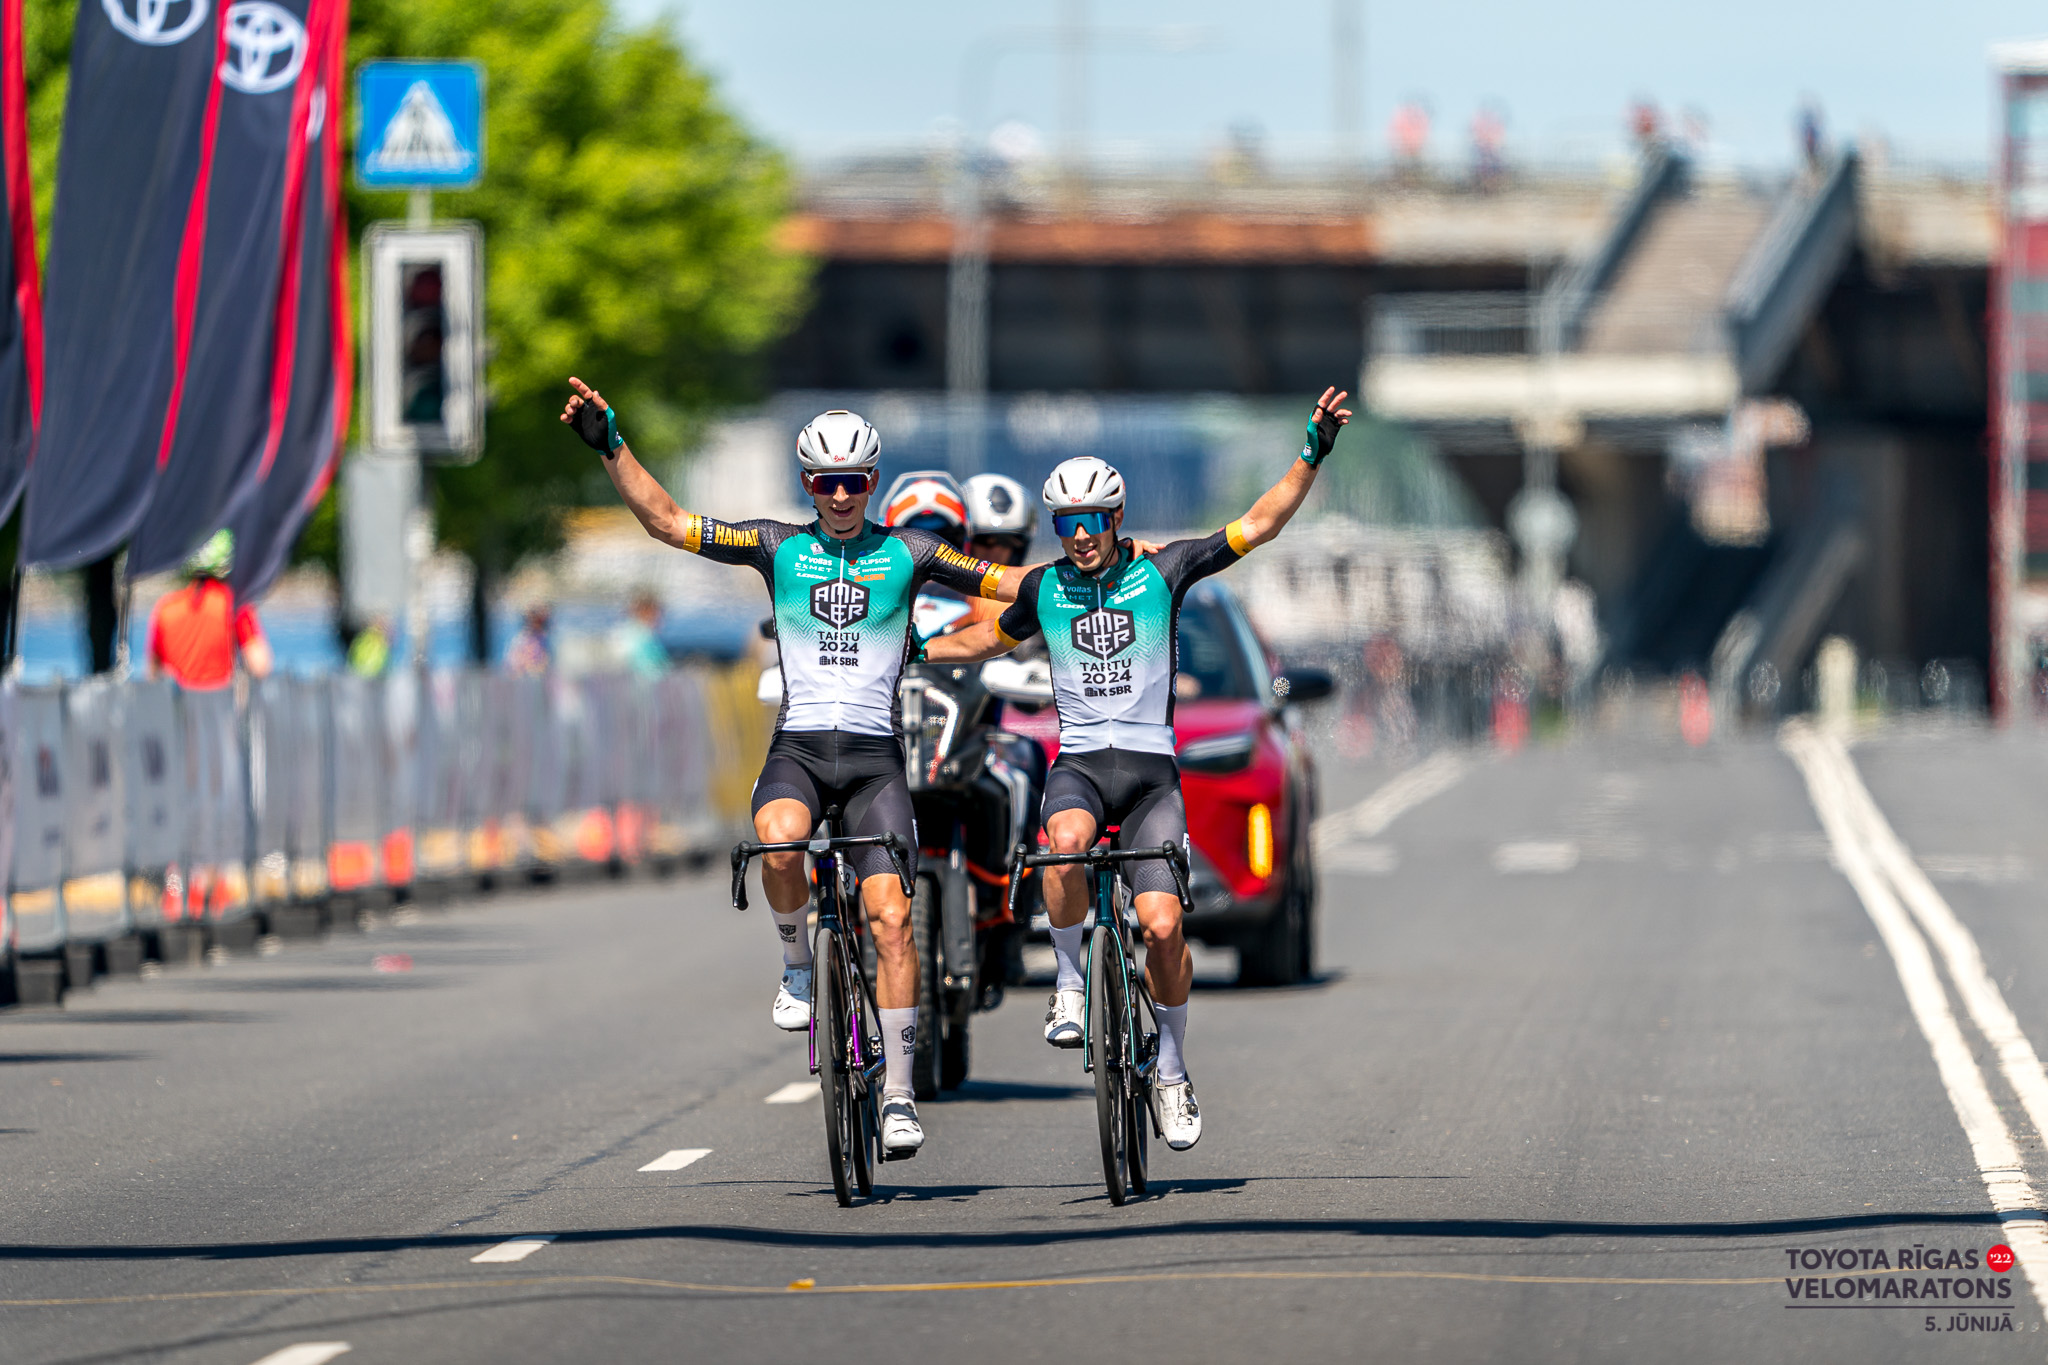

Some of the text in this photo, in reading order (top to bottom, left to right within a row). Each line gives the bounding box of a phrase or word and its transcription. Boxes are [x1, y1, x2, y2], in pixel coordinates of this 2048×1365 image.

[860, 557, 891, 566] SLIPSON
[934, 543, 979, 571] HAWAII
[795, 562, 832, 572] EXMET
[817, 631, 860, 641] TARTU
[819, 641, 859, 654] 2024
[1080, 658, 1132, 672] TARTU
[1082, 669, 1132, 684] 2024
